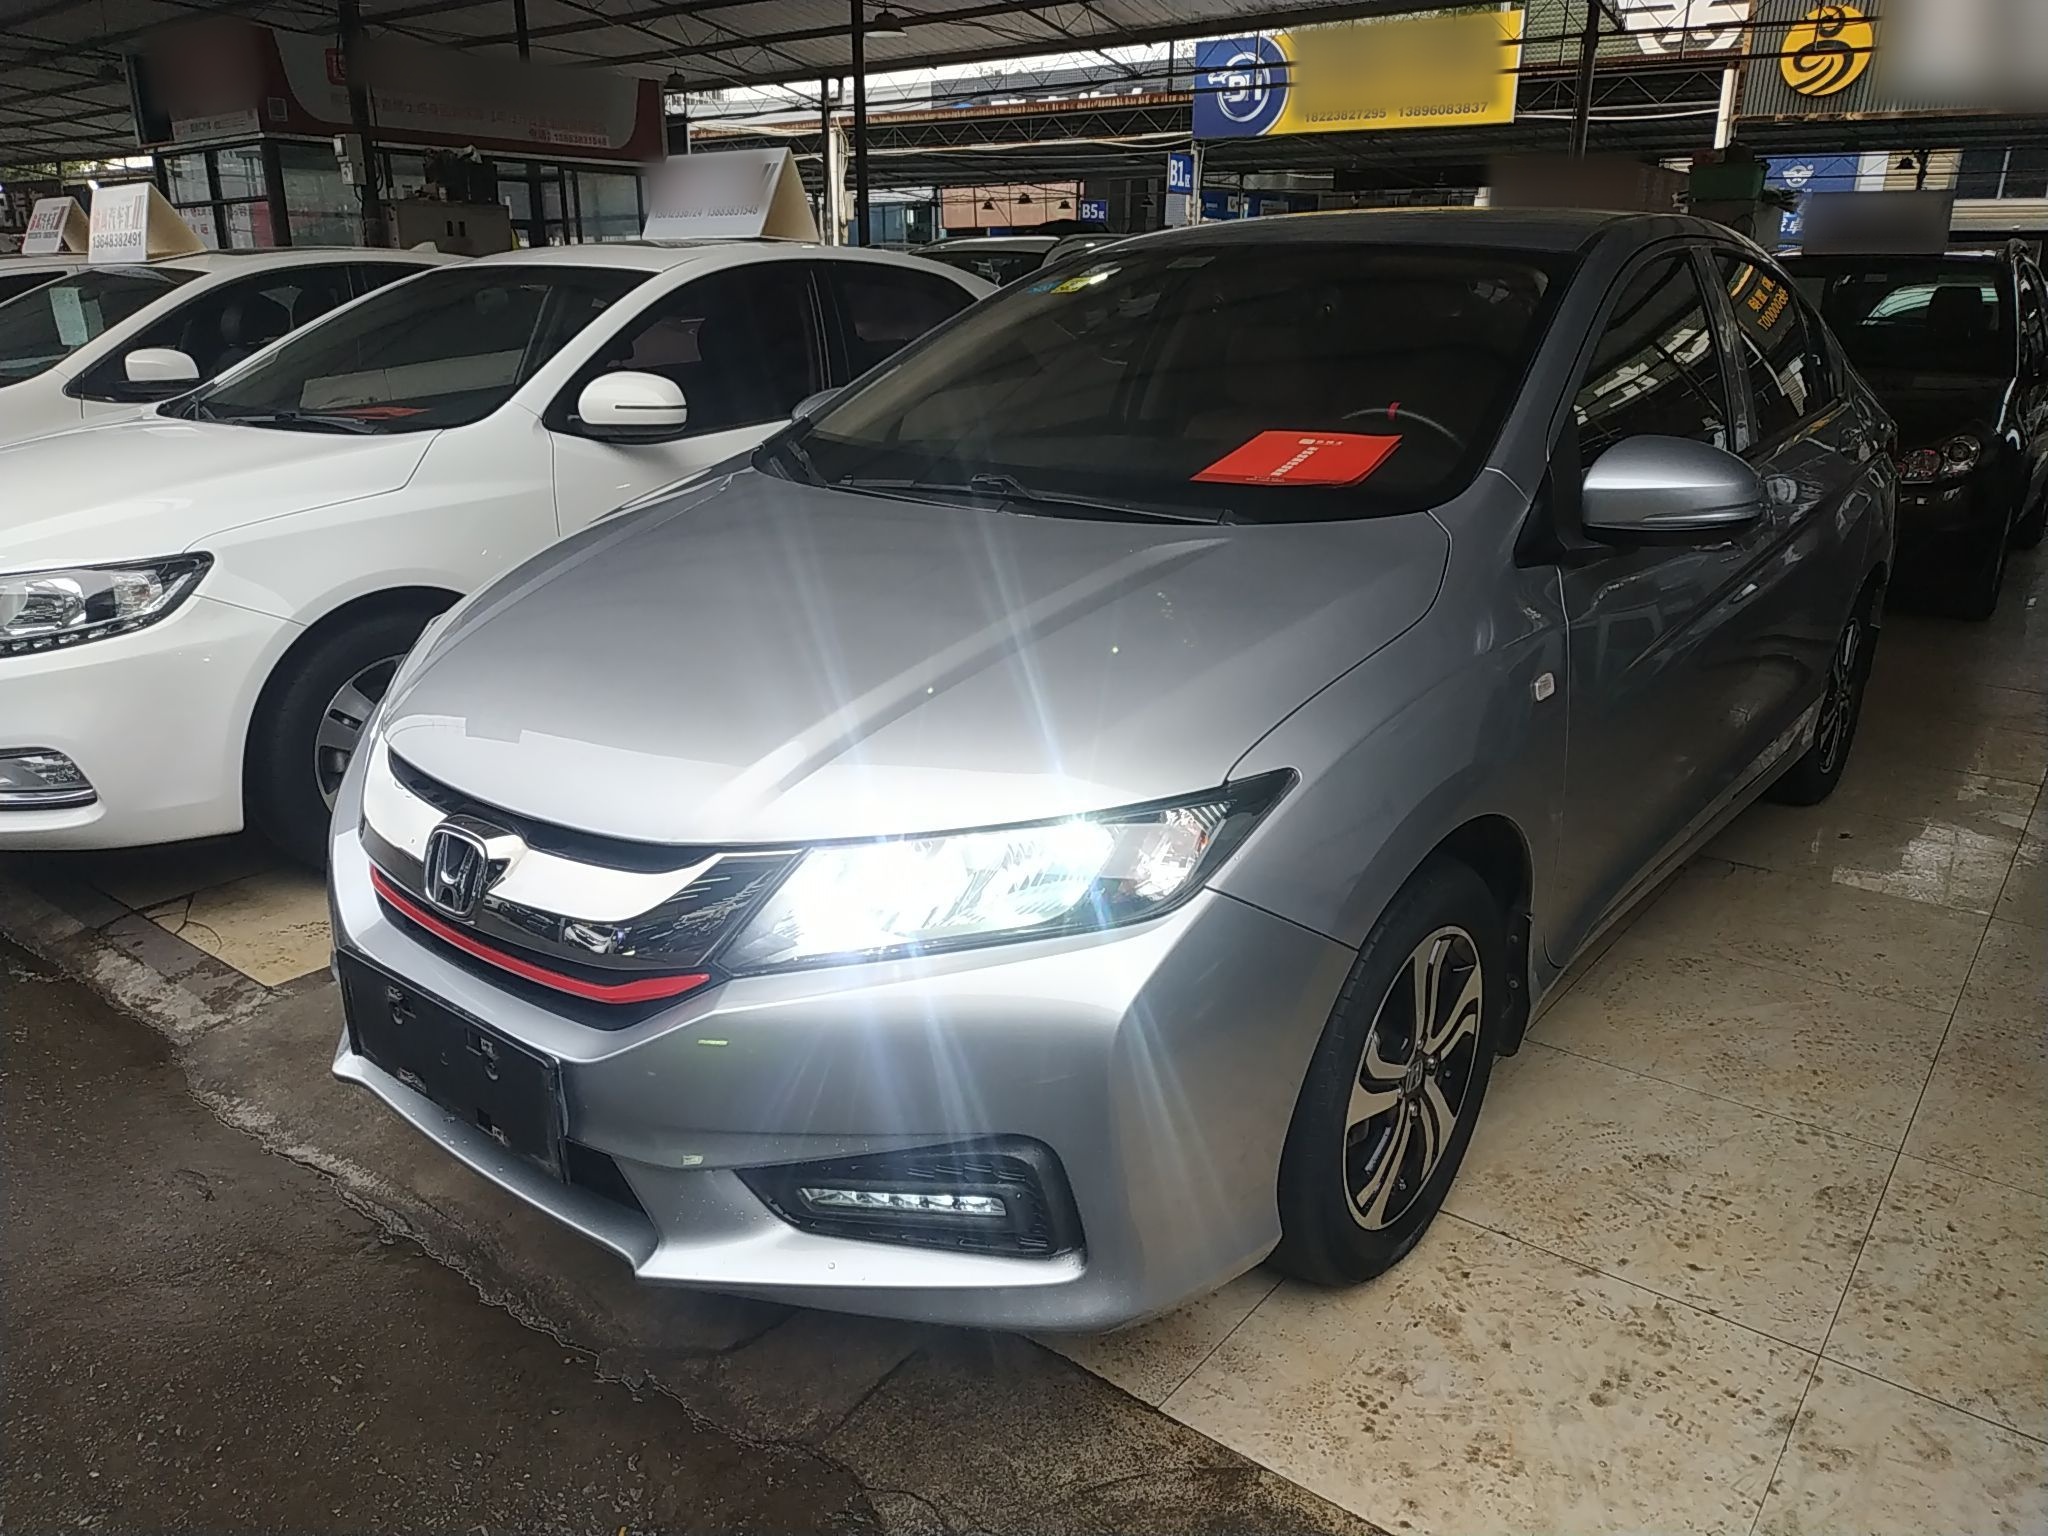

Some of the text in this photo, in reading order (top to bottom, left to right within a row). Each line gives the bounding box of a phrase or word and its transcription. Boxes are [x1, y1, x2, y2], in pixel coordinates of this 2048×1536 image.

[1304, 102, 1489, 123] 18223827295 13896083837
[92, 231, 142, 249] 13648382491
